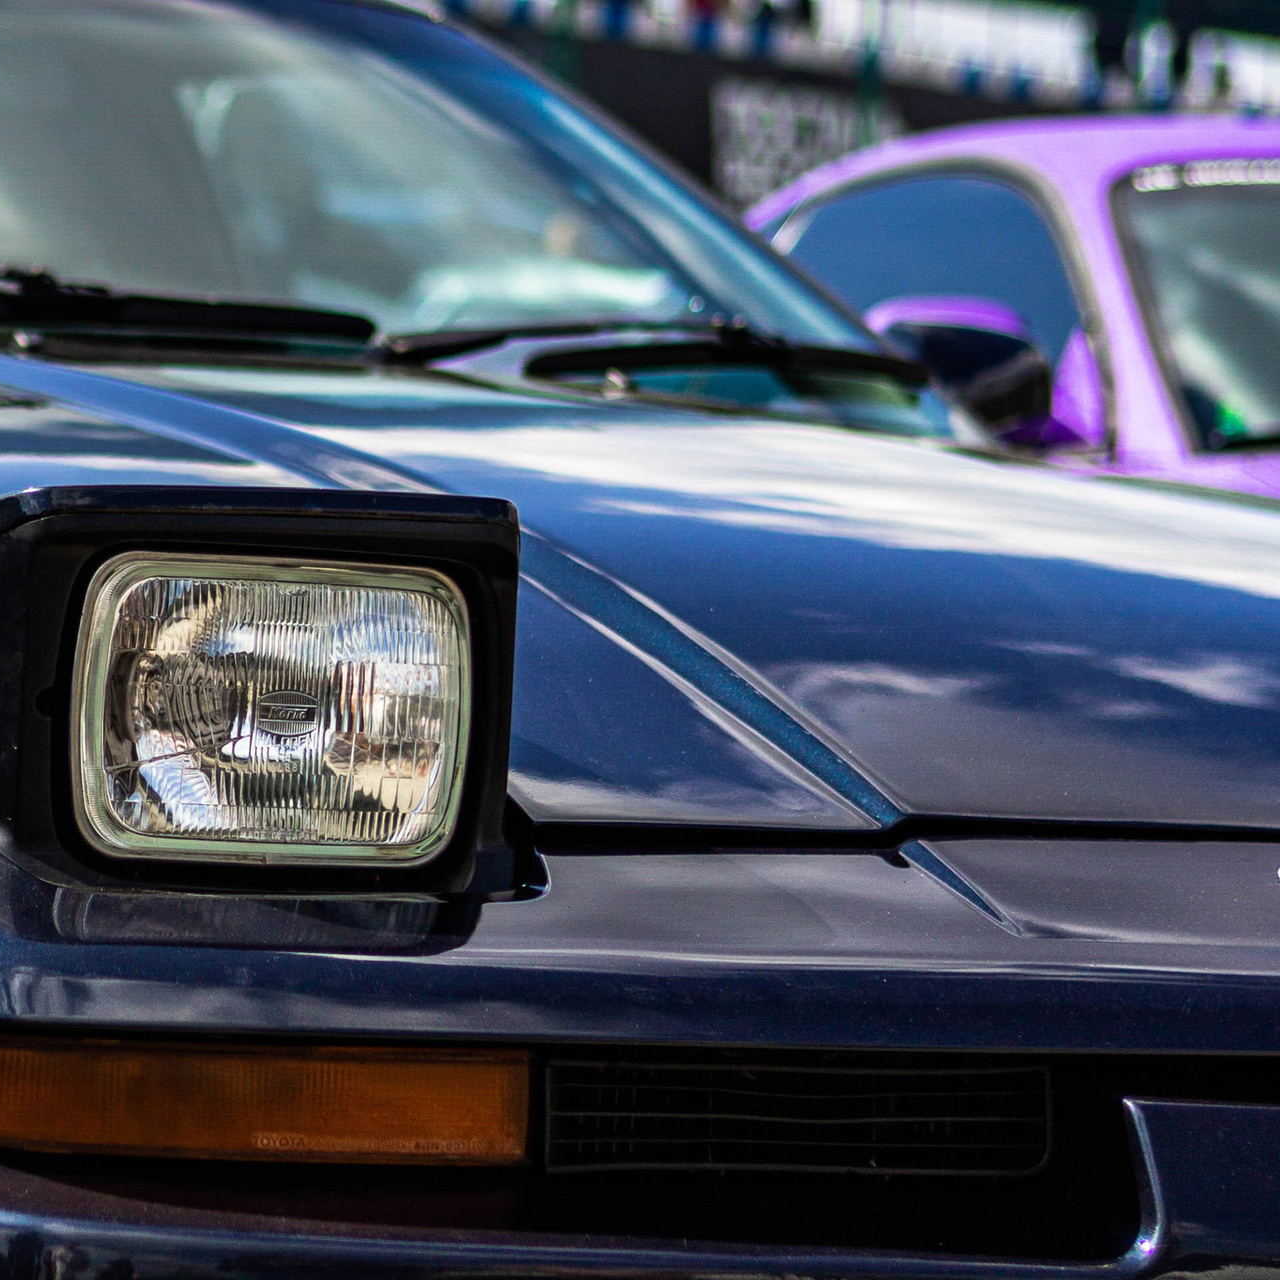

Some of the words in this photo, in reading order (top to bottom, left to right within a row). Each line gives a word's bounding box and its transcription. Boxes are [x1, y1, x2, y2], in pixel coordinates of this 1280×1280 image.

[238, 830, 267, 841] MADE
[271, 831, 281, 841] IN
[285, 831, 317, 842] JAPAN
[252, 1133, 308, 1150] TOYOTA
